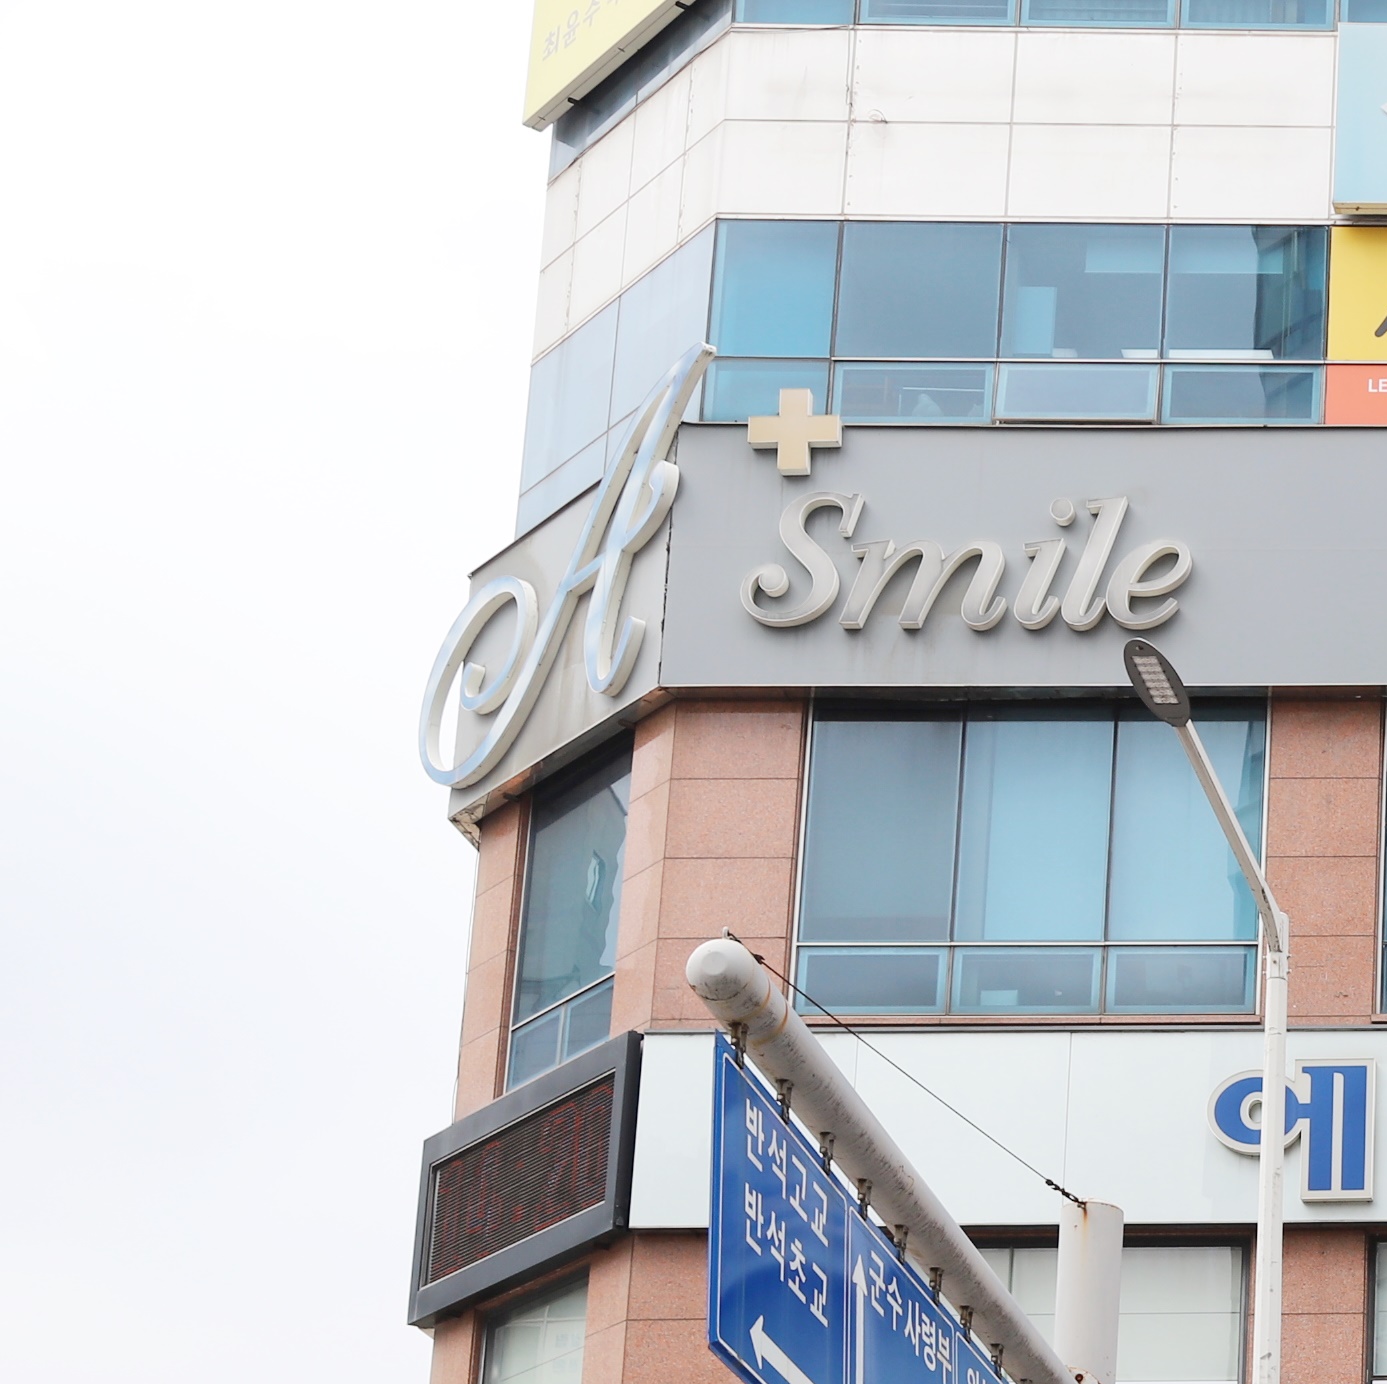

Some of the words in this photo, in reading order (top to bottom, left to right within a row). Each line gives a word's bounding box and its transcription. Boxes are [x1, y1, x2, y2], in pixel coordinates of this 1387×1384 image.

[740, 491, 1194, 633] Smile
[744, 1097, 830, 1249] 반석고교
[743, 1181, 830, 1329] 반석초교
